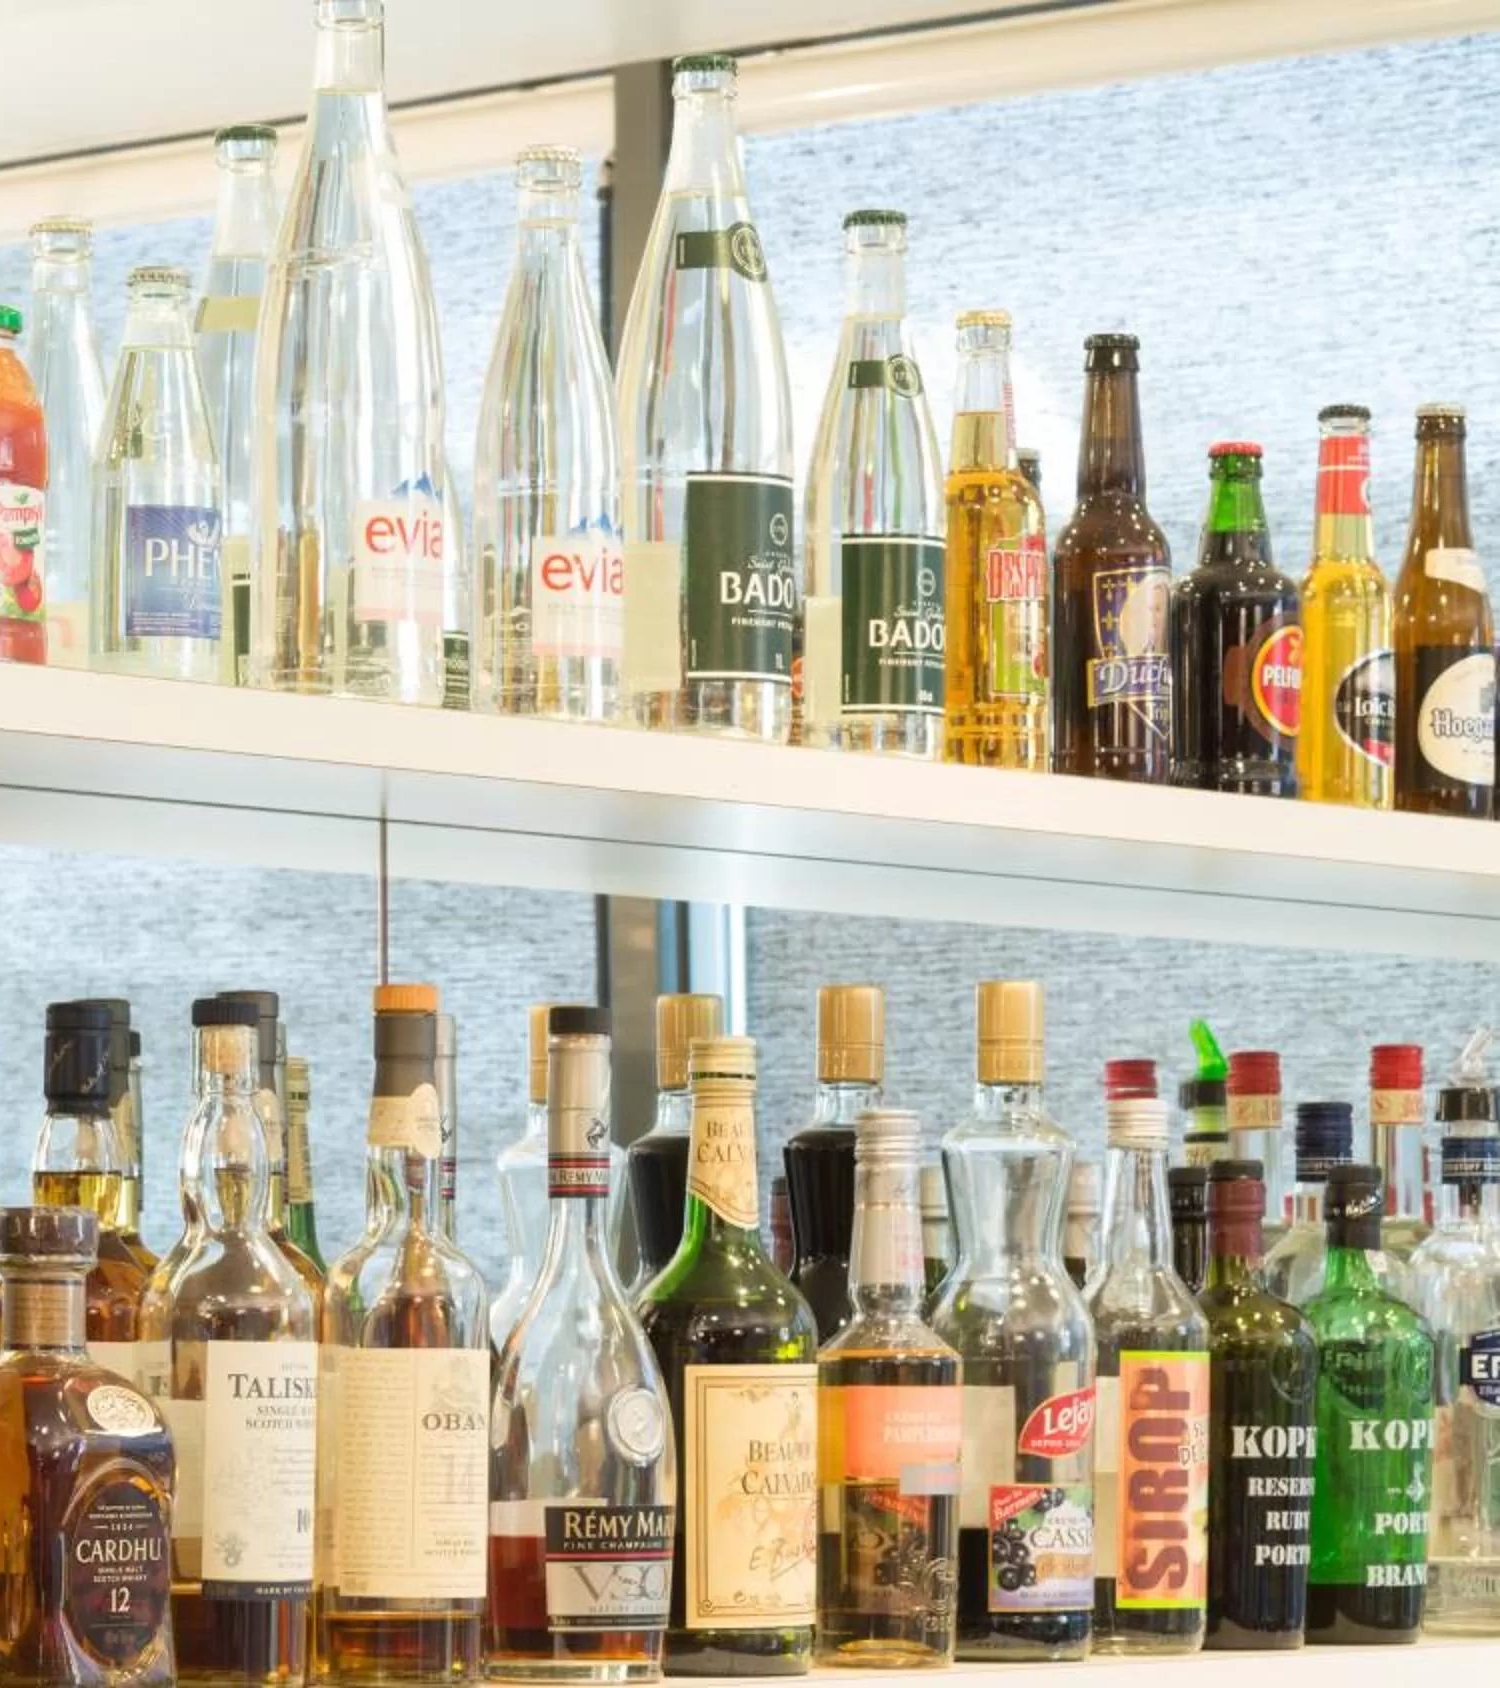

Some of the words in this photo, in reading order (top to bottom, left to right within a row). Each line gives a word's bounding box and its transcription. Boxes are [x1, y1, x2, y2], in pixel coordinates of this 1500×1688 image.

[720, 571, 794, 609] BADO
[1263, 664, 1300, 688] PELFO
[1126, 1367, 1190, 1590] SIROP
[564, 1509, 632, 1539] RÉMY
[76, 1538, 162, 1563] CARDHU
[111, 1587, 130, 1612] 12
